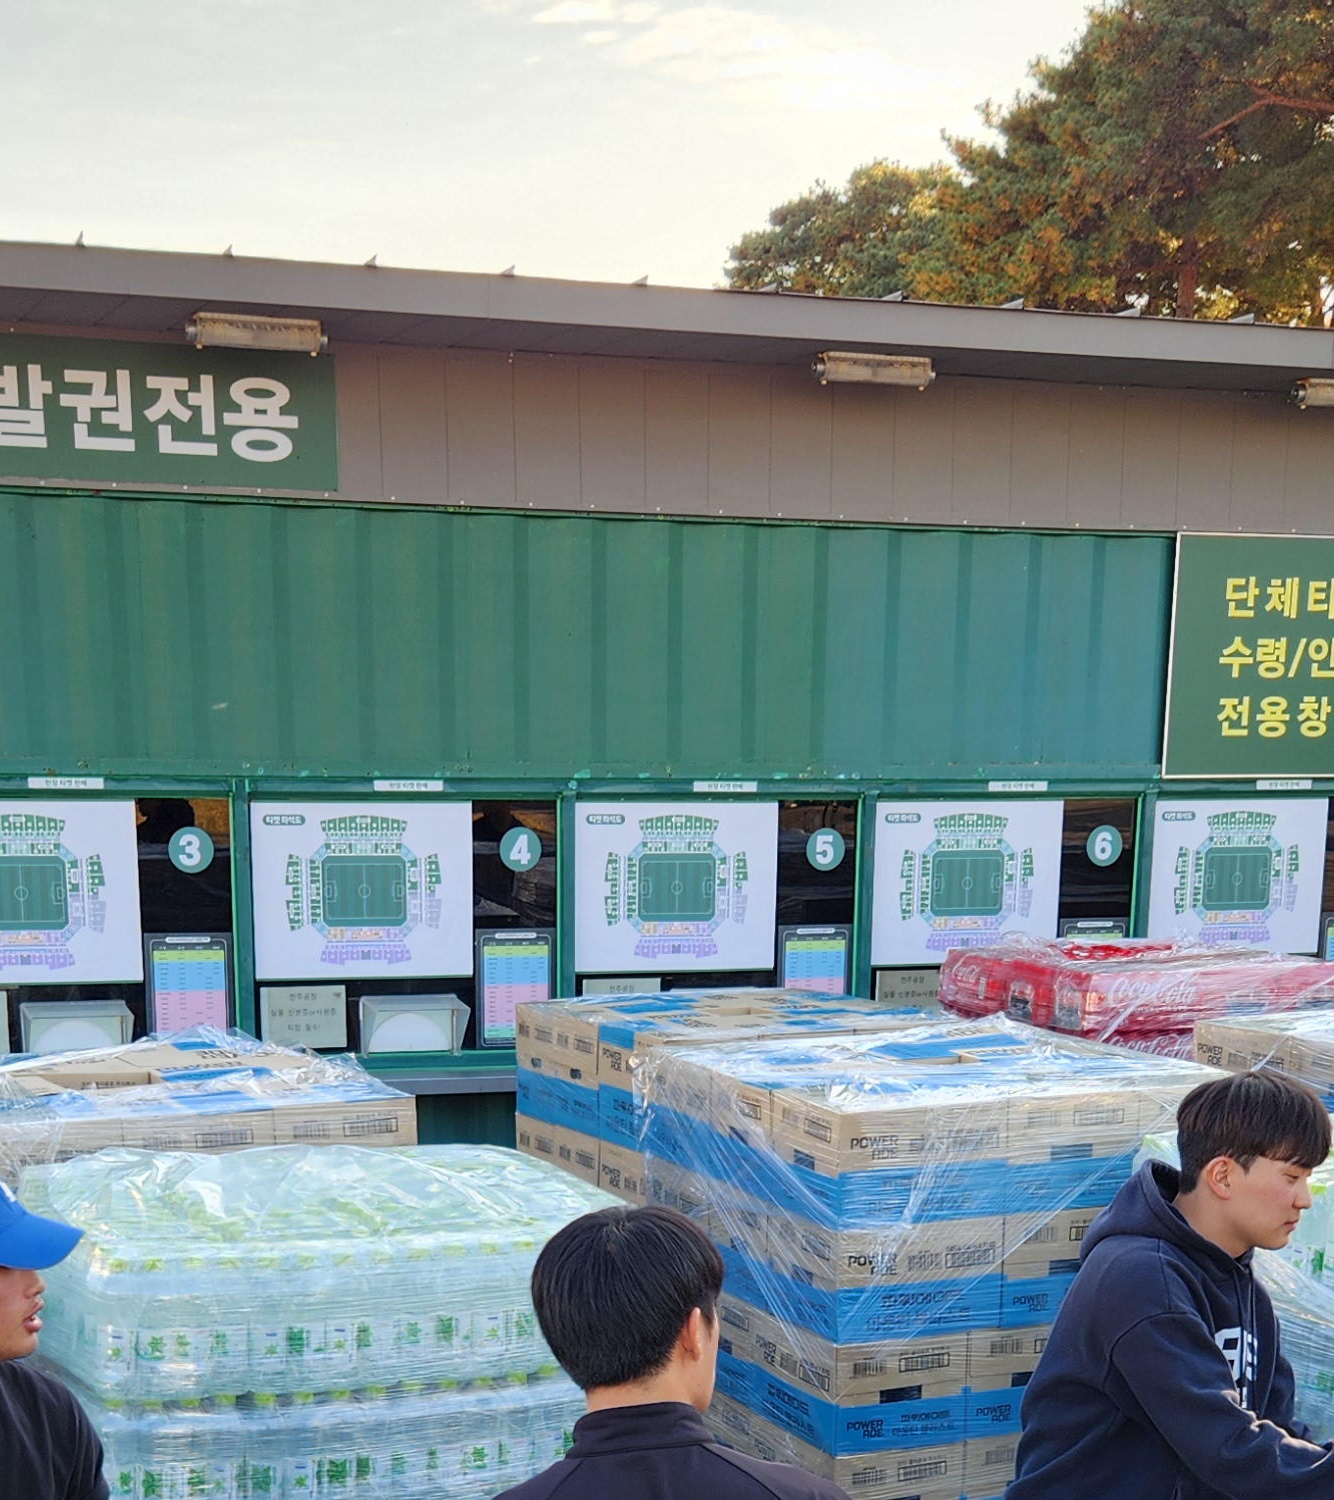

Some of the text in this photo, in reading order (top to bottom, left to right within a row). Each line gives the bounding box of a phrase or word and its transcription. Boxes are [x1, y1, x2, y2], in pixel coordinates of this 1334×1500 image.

[178, 834, 202, 867] 3
[509, 834, 531, 865] 4
[815, 835, 835, 866] 5
[1093, 832, 1113, 861] 6
[1197, 1043, 1223, 1056] POWER
[1012, 1293, 1049, 1306] POWER
[976, 1404, 1012, 1417] POWER
[847, 1419, 884, 1432] POWER
